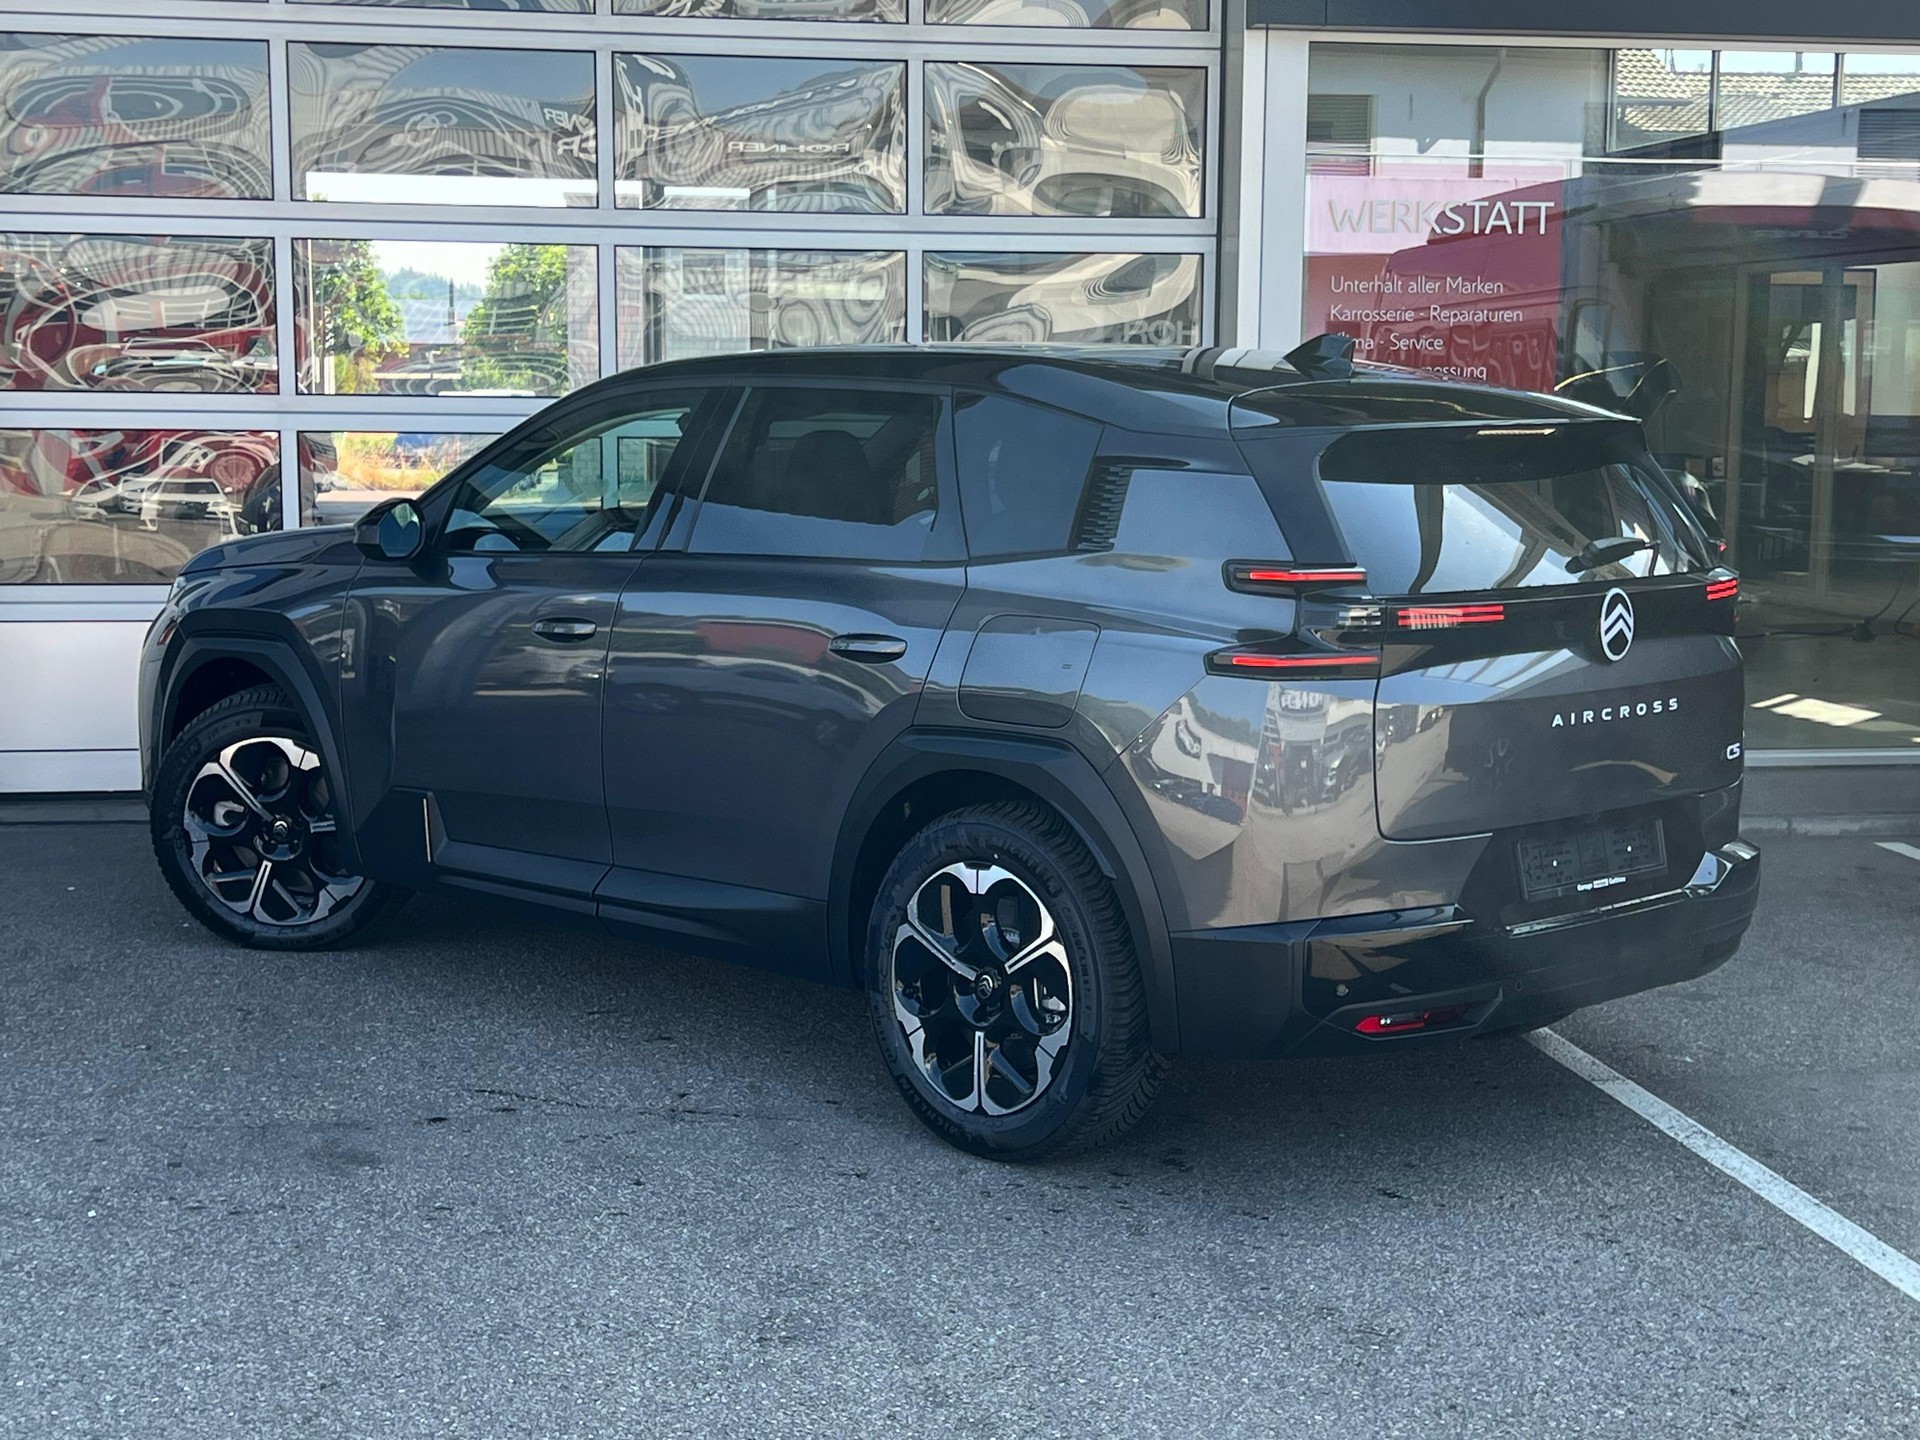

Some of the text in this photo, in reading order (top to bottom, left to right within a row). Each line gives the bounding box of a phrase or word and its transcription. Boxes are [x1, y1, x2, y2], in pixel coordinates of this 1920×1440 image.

[1329, 200, 1555, 235] WERKSTATT
[1331, 276, 1503, 294] Unterhalt aller Marken
[1330, 304, 1415, 322] Karrosserie
[1430, 304, 1523, 326] Reparaturen
[1389, 333, 1443, 350] Service
[1552, 698, 1678, 727] AIRCROSS
